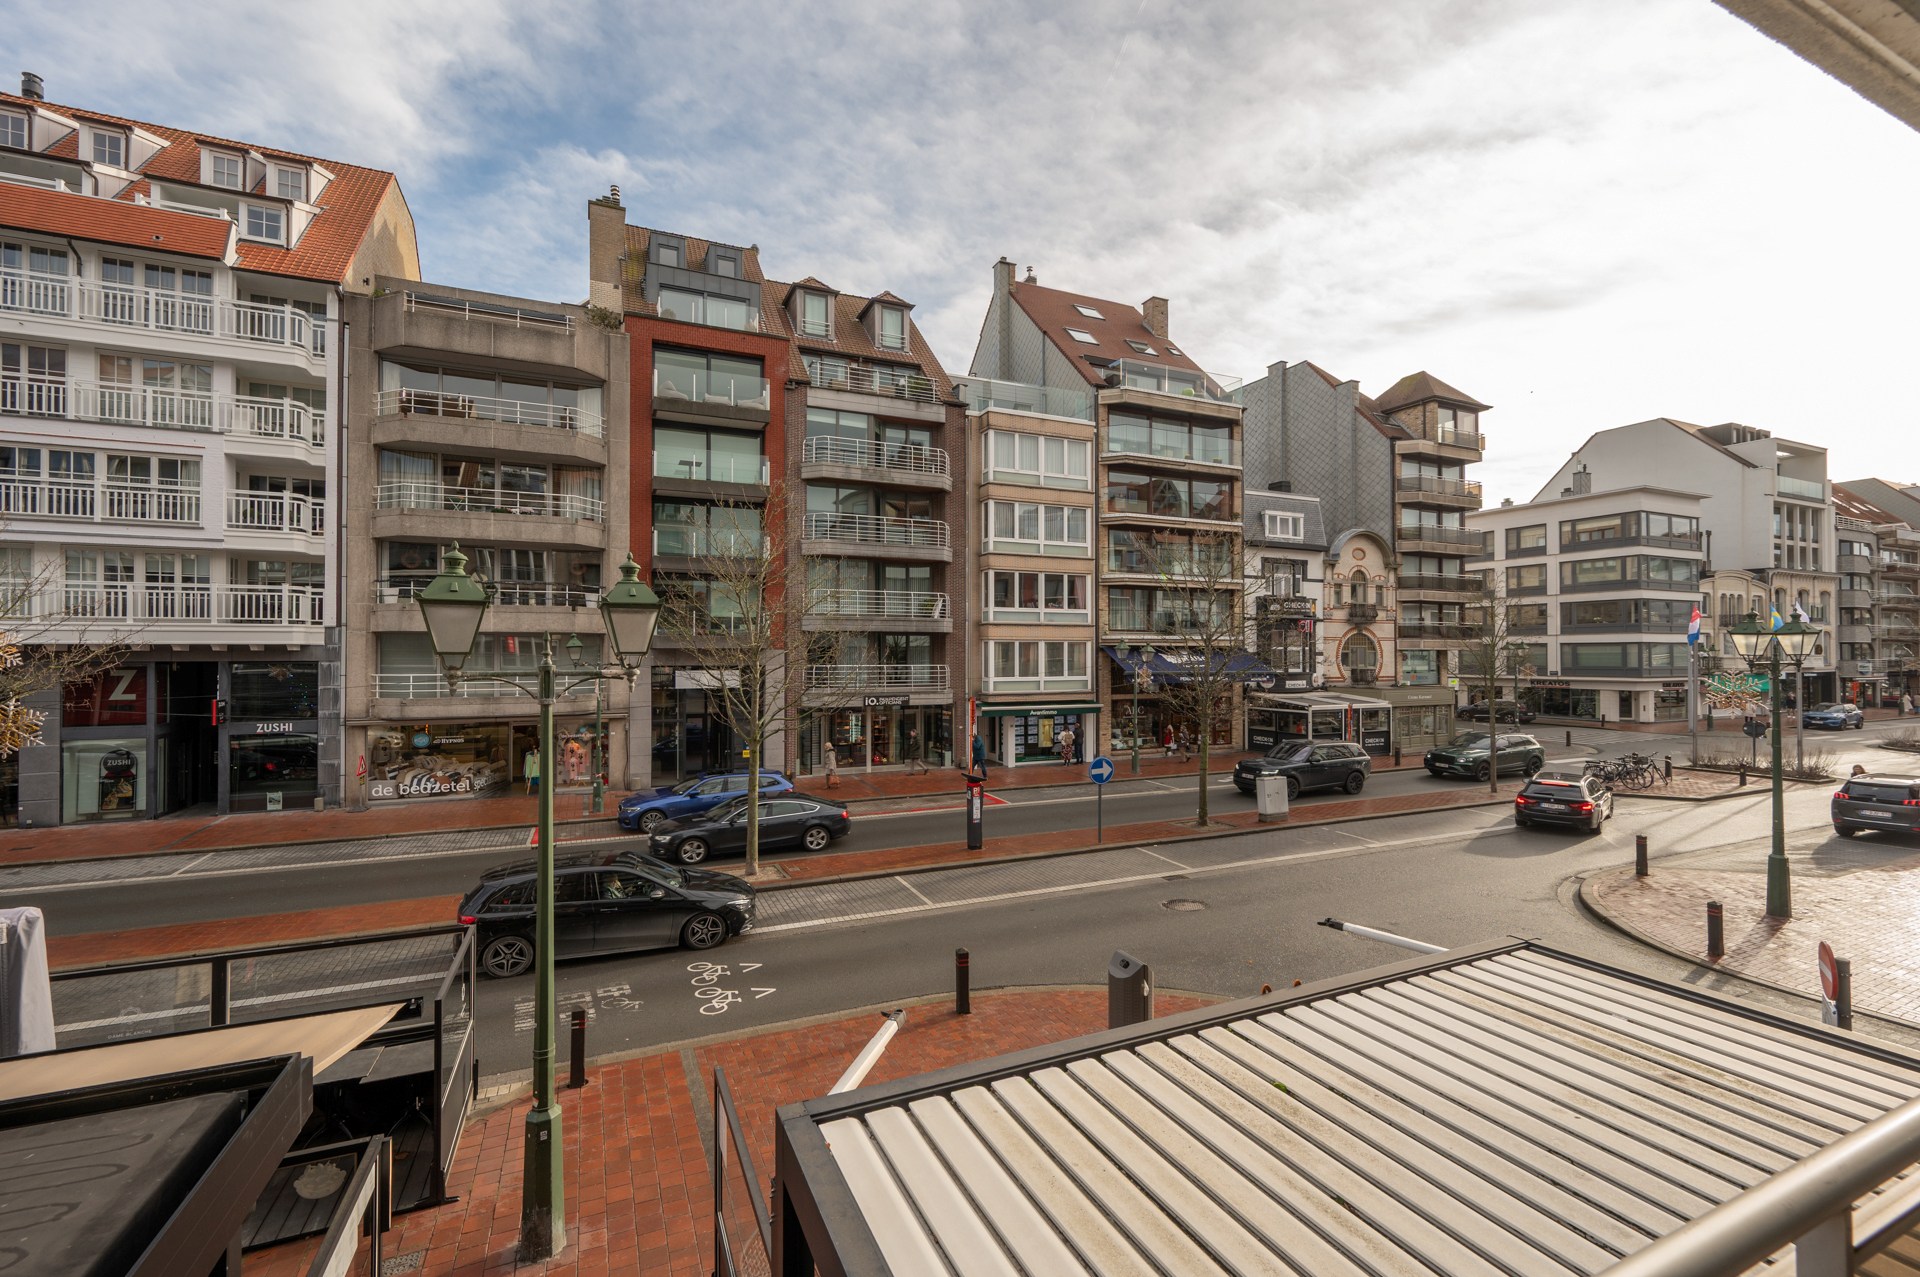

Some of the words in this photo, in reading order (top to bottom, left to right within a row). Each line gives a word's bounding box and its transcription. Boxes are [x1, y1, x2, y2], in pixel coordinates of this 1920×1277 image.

[109, 669, 138, 700] Z
[256, 722, 293, 733] ZUSHI
[371, 784, 393, 797] de
[398, 779, 471, 796] bedzetel
